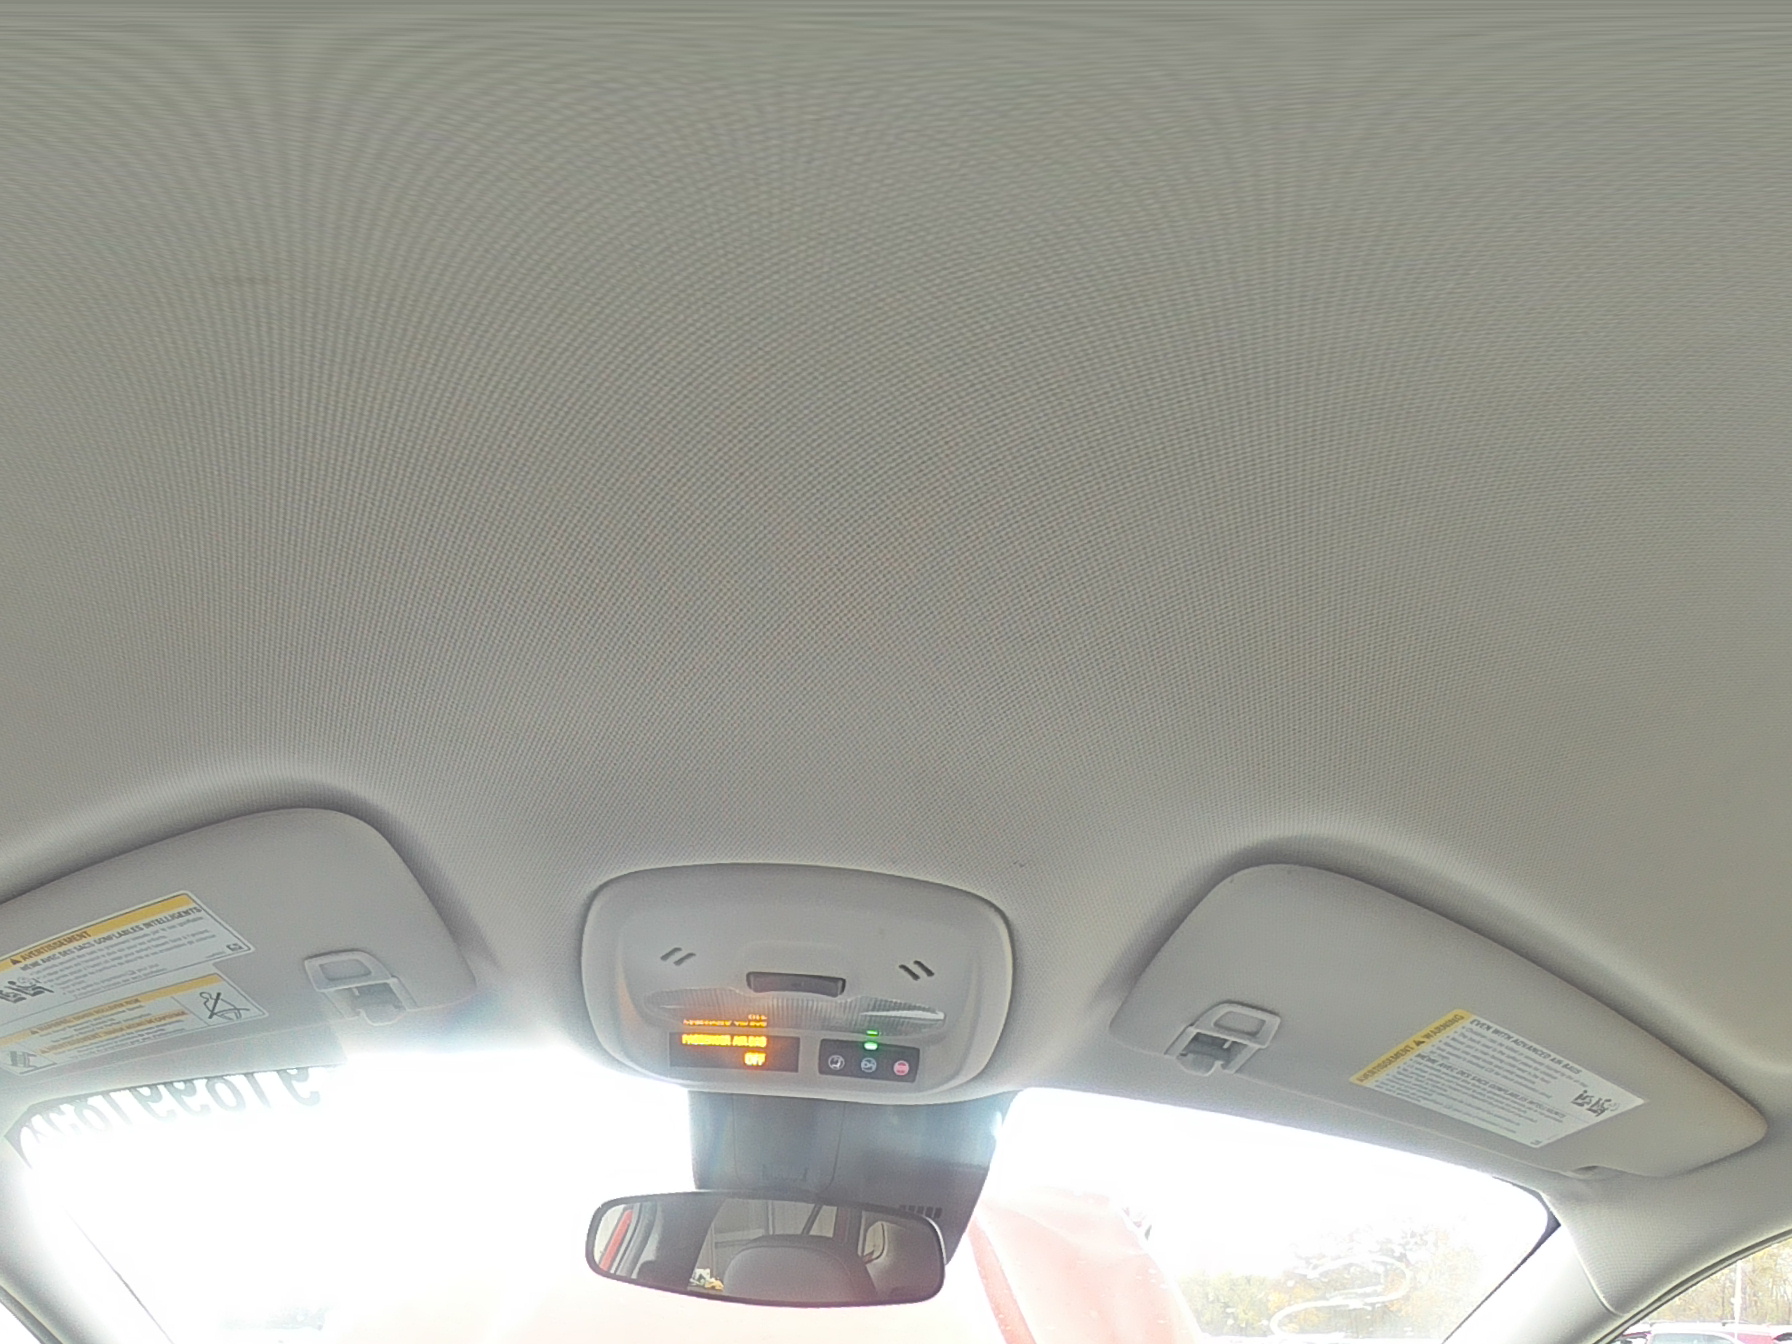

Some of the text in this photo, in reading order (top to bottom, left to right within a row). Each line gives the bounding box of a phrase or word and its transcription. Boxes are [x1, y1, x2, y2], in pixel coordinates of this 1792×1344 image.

[141, 905, 202, 929] INTELLIGENTS
[20, 930, 92, 961] AVERTISSEMENT
[1422, 1013, 1464, 1040] WARNING
[682, 1034, 731, 1046] PASSENGER
[744, 1052, 767, 1066] OFF
